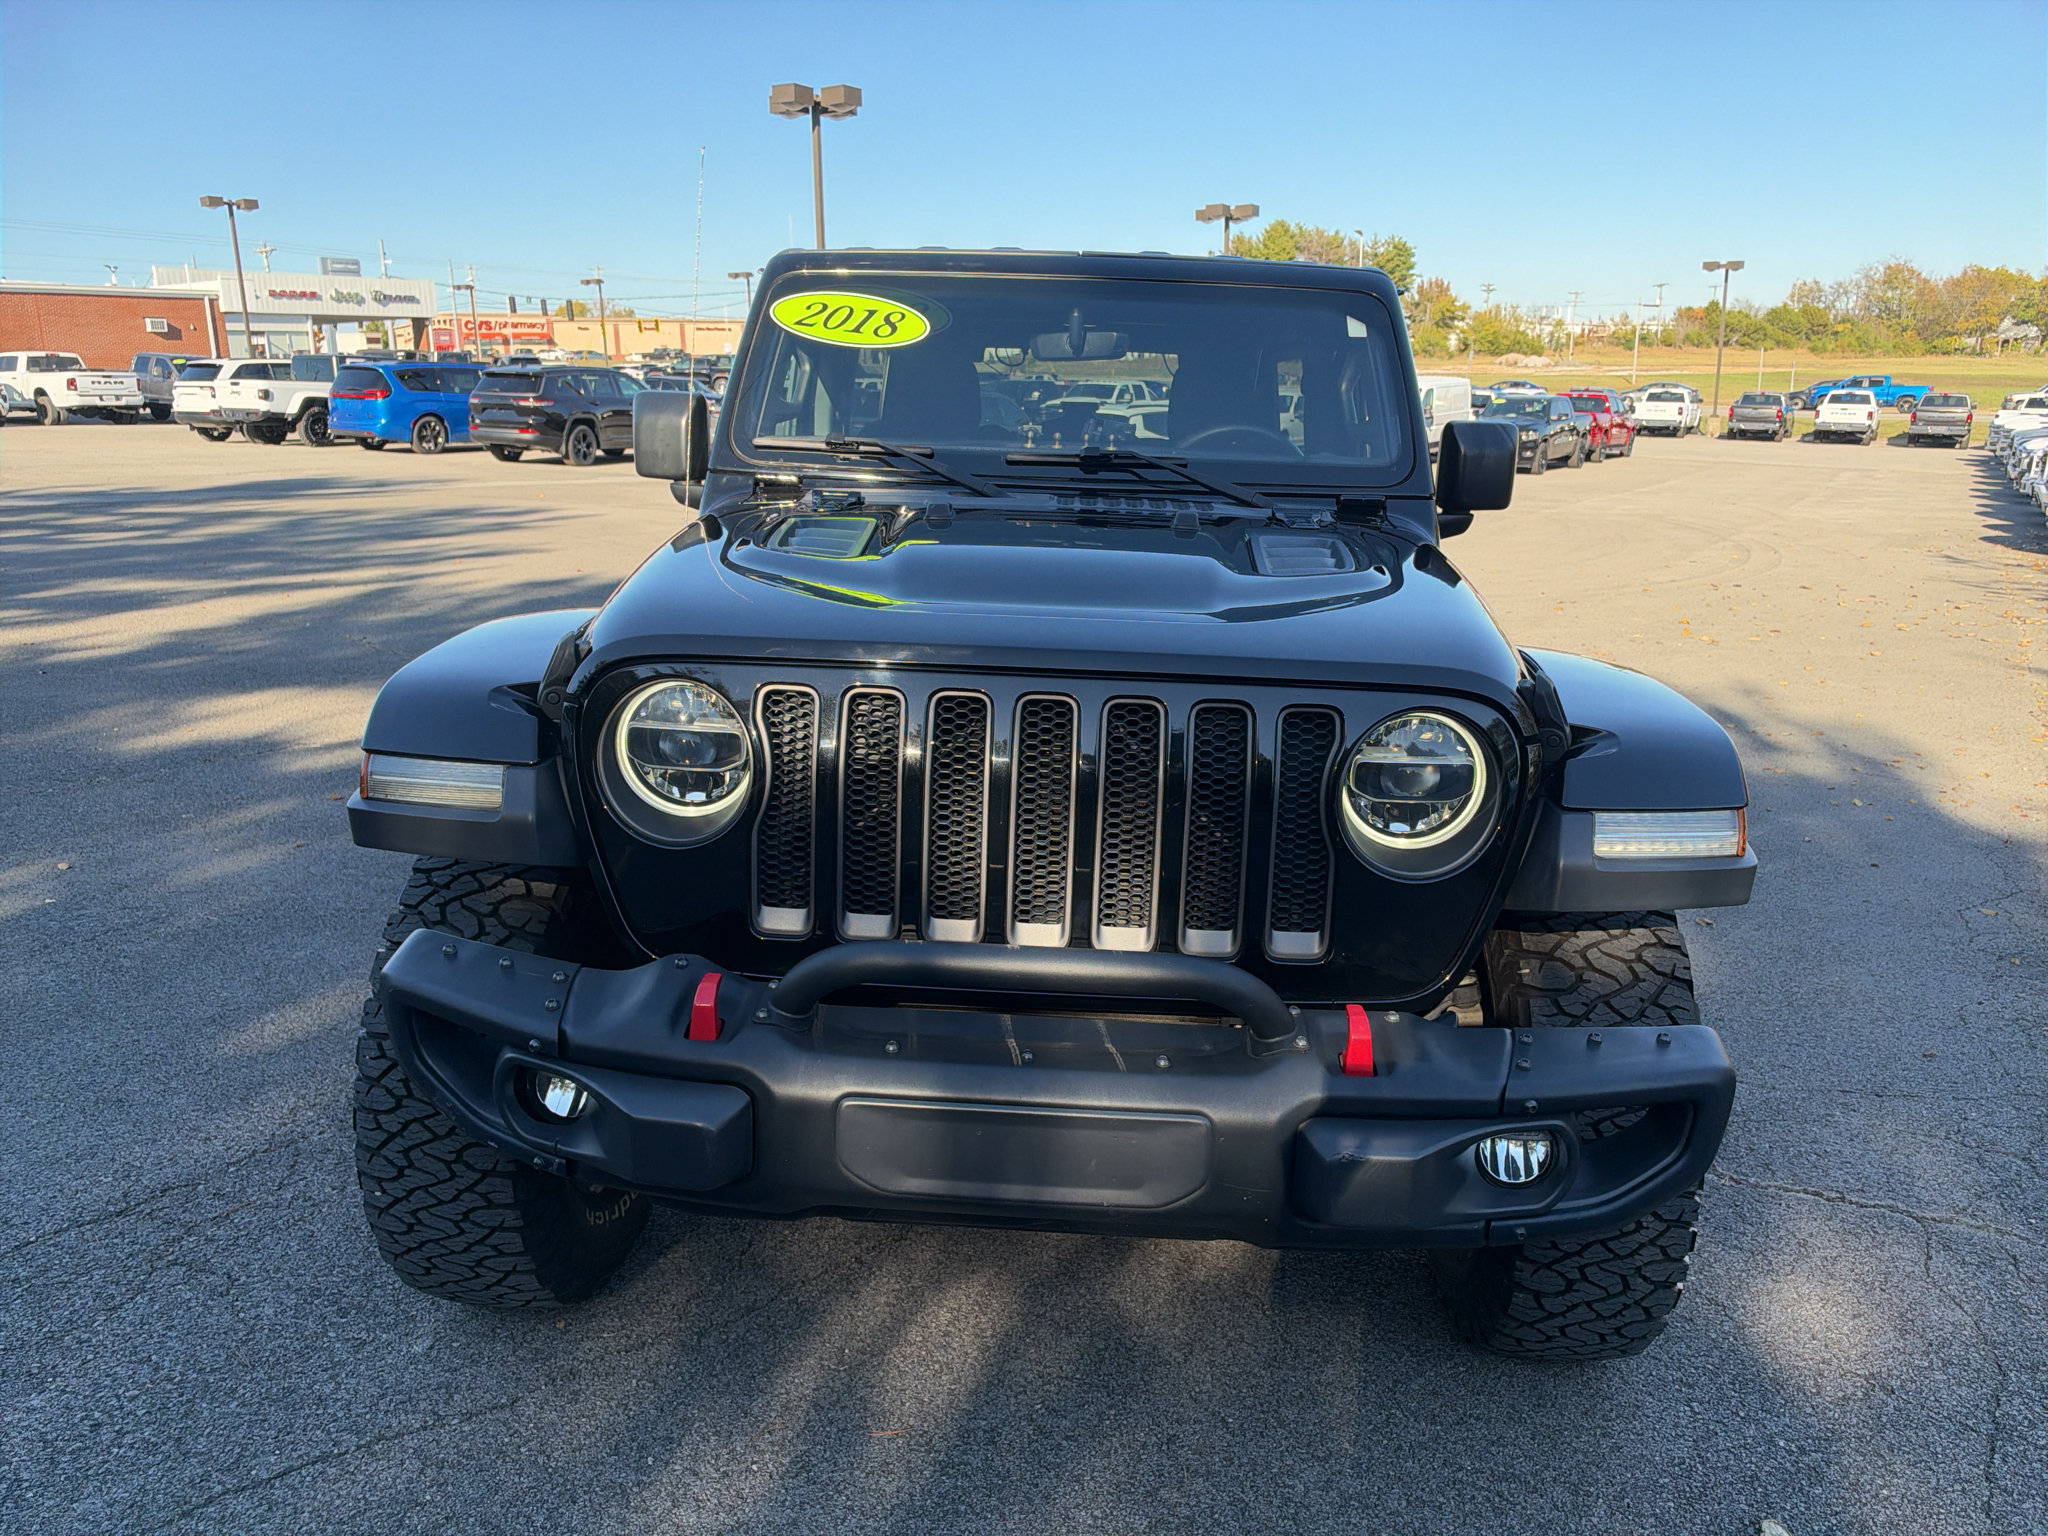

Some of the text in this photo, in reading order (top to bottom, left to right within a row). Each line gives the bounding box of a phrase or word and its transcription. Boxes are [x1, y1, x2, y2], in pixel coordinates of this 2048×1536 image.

[268, 289, 317, 298] DODGE
[329, 287, 361, 303] Jeep
[792, 301, 907, 338] 2018
